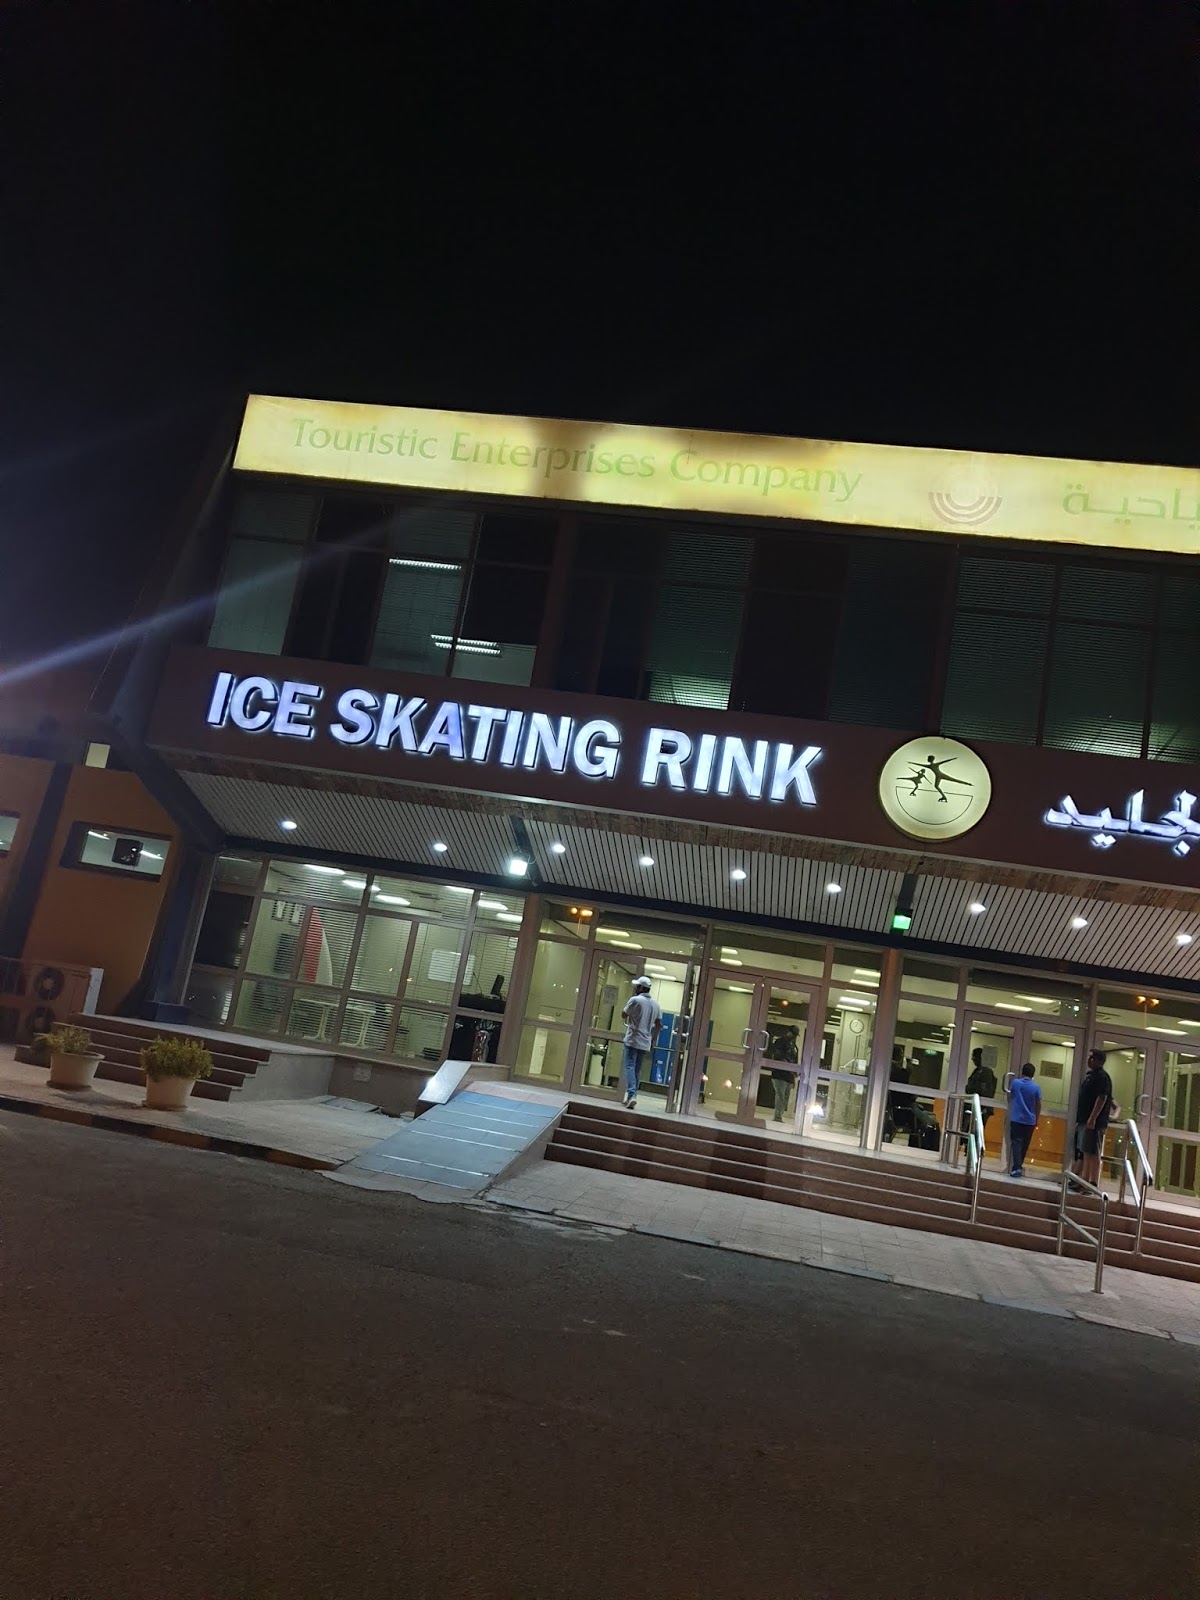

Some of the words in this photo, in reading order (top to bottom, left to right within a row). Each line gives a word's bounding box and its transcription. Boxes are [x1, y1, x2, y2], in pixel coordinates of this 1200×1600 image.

[291, 418, 438, 460] Touristic
[450, 431, 655, 478] Enterprises
[669, 449, 863, 503] Company
[206, 671, 323, 739] ICE
[329, 687, 621, 780] SKATING
[640, 727, 823, 806] RINK
